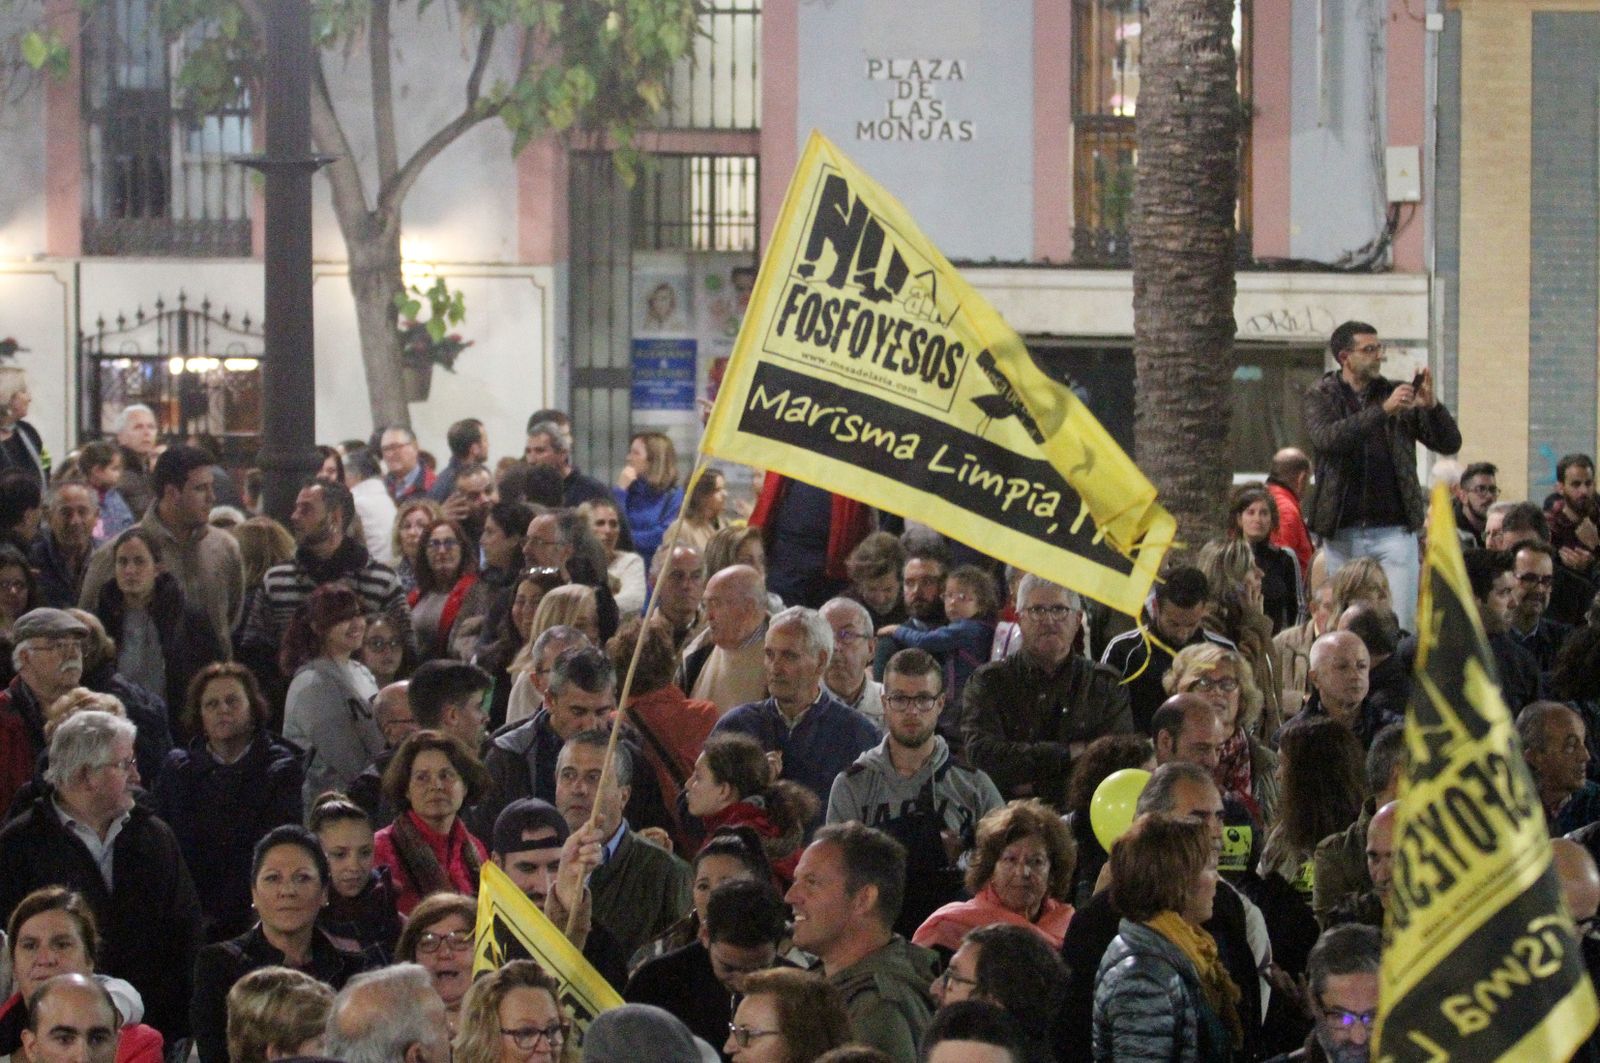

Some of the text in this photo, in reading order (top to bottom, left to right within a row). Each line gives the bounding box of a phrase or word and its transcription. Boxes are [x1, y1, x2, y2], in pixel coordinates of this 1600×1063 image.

[867, 59, 963, 80] PLAZA
[898, 81, 933, 100] DE
[888, 100, 943, 120] LAS
[857, 120, 973, 141] MONJAS
[776, 283, 965, 390] FOSFOYESOS
[749, 384, 920, 460] Marisma
